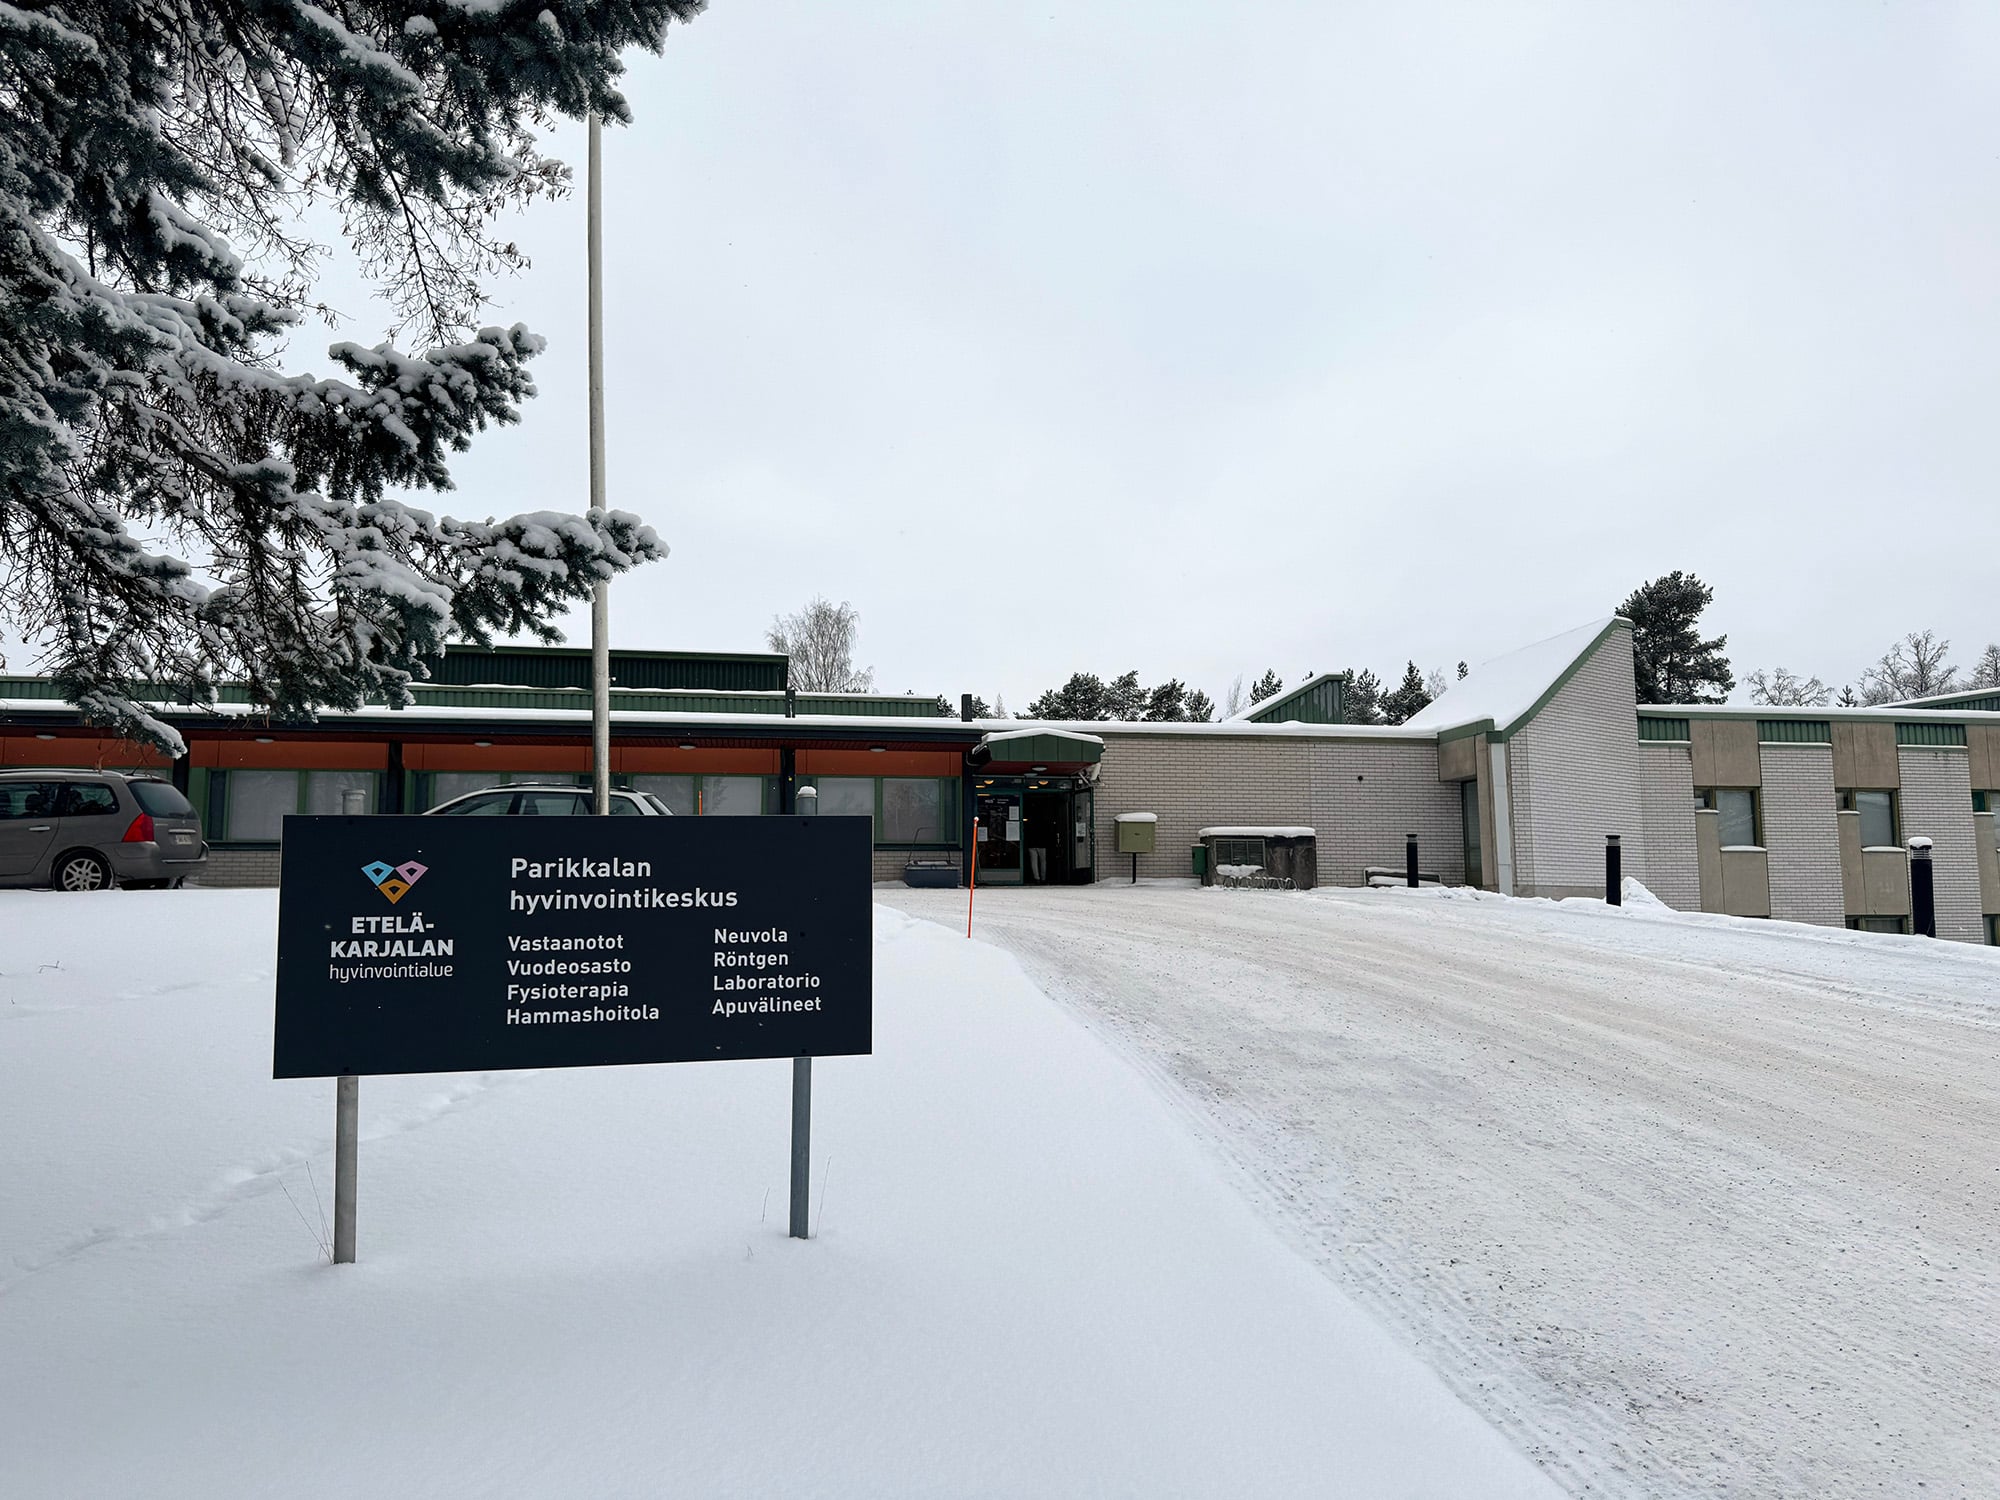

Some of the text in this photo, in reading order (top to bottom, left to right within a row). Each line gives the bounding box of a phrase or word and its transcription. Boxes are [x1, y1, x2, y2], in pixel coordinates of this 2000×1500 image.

[512, 858, 651, 879] Parikkalan
[510, 888, 738, 914] hyvinvointikeskus
[351, 912, 435, 934] ETELÄ-
[508, 934, 624, 952] Vastaanotot
[714, 928, 788, 944] Neuvola
[330, 939, 454, 958] KARJALAN
[507, 958, 632, 976] Vuodeosasto
[713, 950, 789, 970] Röntgen
[329, 962, 454, 983] hyvinvointialue
[713, 973, 821, 991] Laboratorio
[507, 981, 629, 1002] Fysioterapia
[506, 1004, 660, 1025] Hammashoitola
[711, 996, 822, 1017] Apuvälineet
